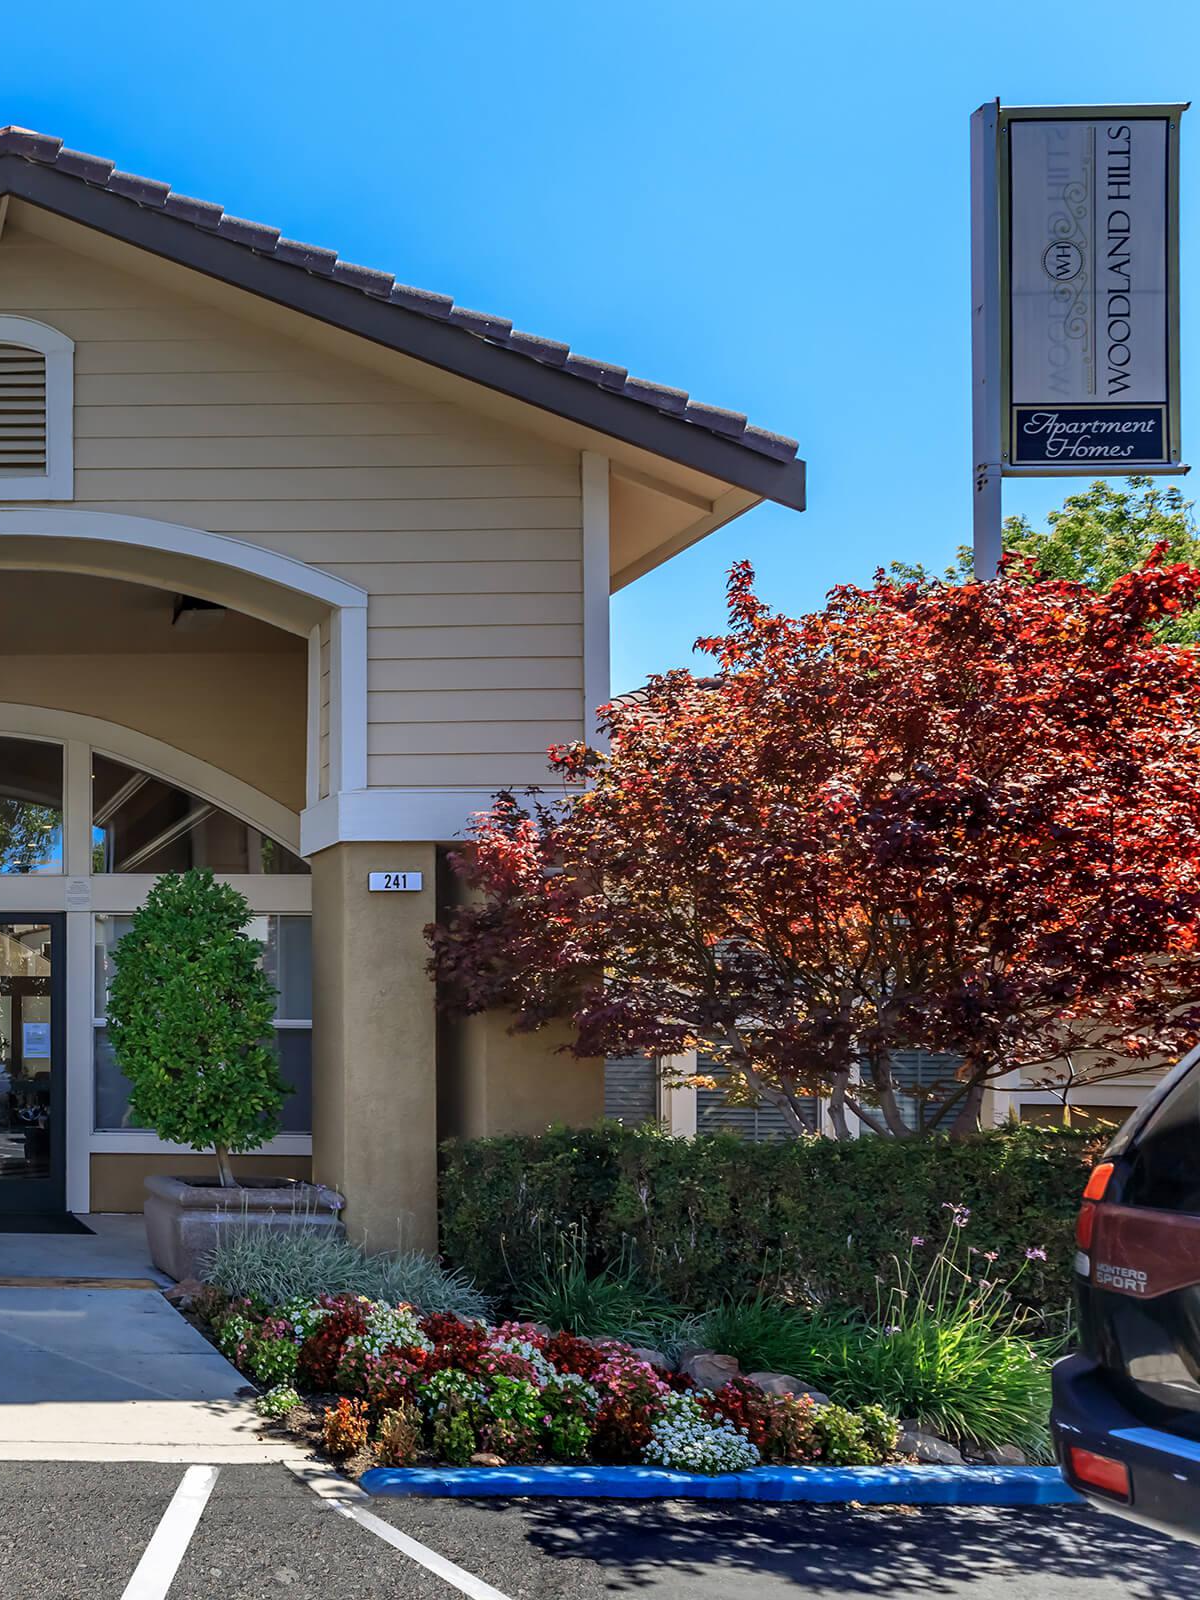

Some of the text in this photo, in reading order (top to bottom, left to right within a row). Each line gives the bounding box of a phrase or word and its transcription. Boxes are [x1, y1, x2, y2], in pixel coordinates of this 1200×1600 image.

[1056, 245, 1071, 277] WH
[1107, 125, 1131, 397] WOODLAND HILLS
[1023, 412, 1155, 444] Apartment
[1045, 434, 1134, 458] Homes
[384, 874, 407, 889] 241
[1096, 1271, 1147, 1293] SPORT
